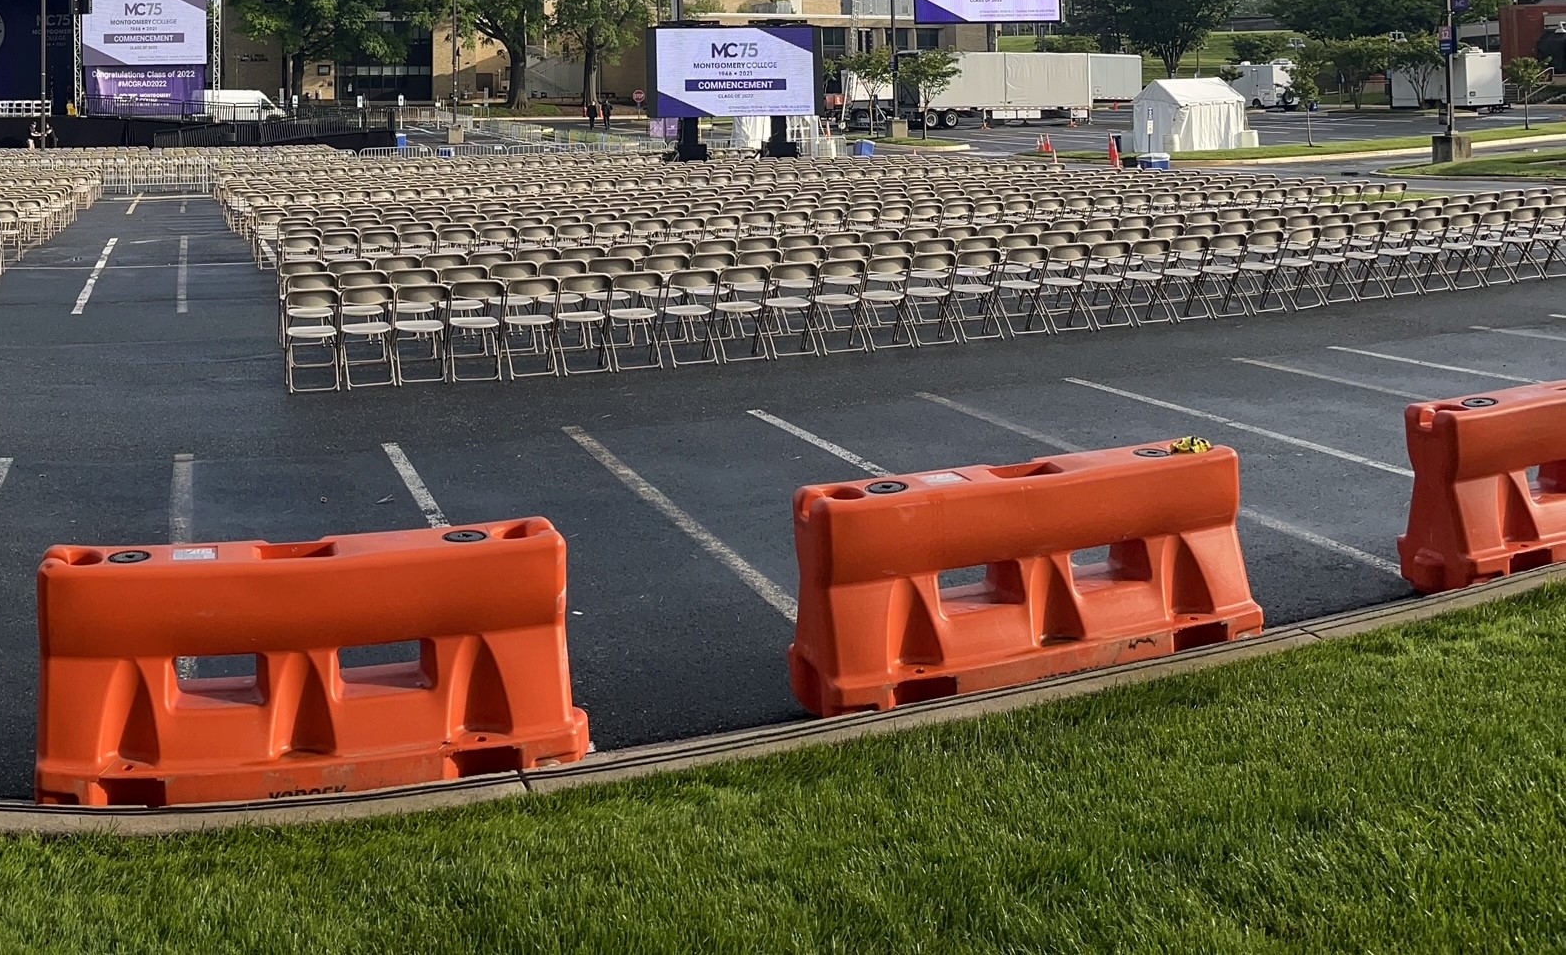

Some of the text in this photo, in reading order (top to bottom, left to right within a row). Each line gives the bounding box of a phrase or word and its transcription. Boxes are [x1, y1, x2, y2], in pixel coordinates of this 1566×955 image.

[124, 3, 162, 16] MC75
[114, 35, 174, 43] COMMENCEMENT
[1441, 31, 1450, 39] 12
[711, 43, 758, 59] MC75
[746, 61, 778, 69] COLLEGE
[92, 71, 144, 79] Congratulations
[698, 81, 774, 89] COMMENCEMENT
